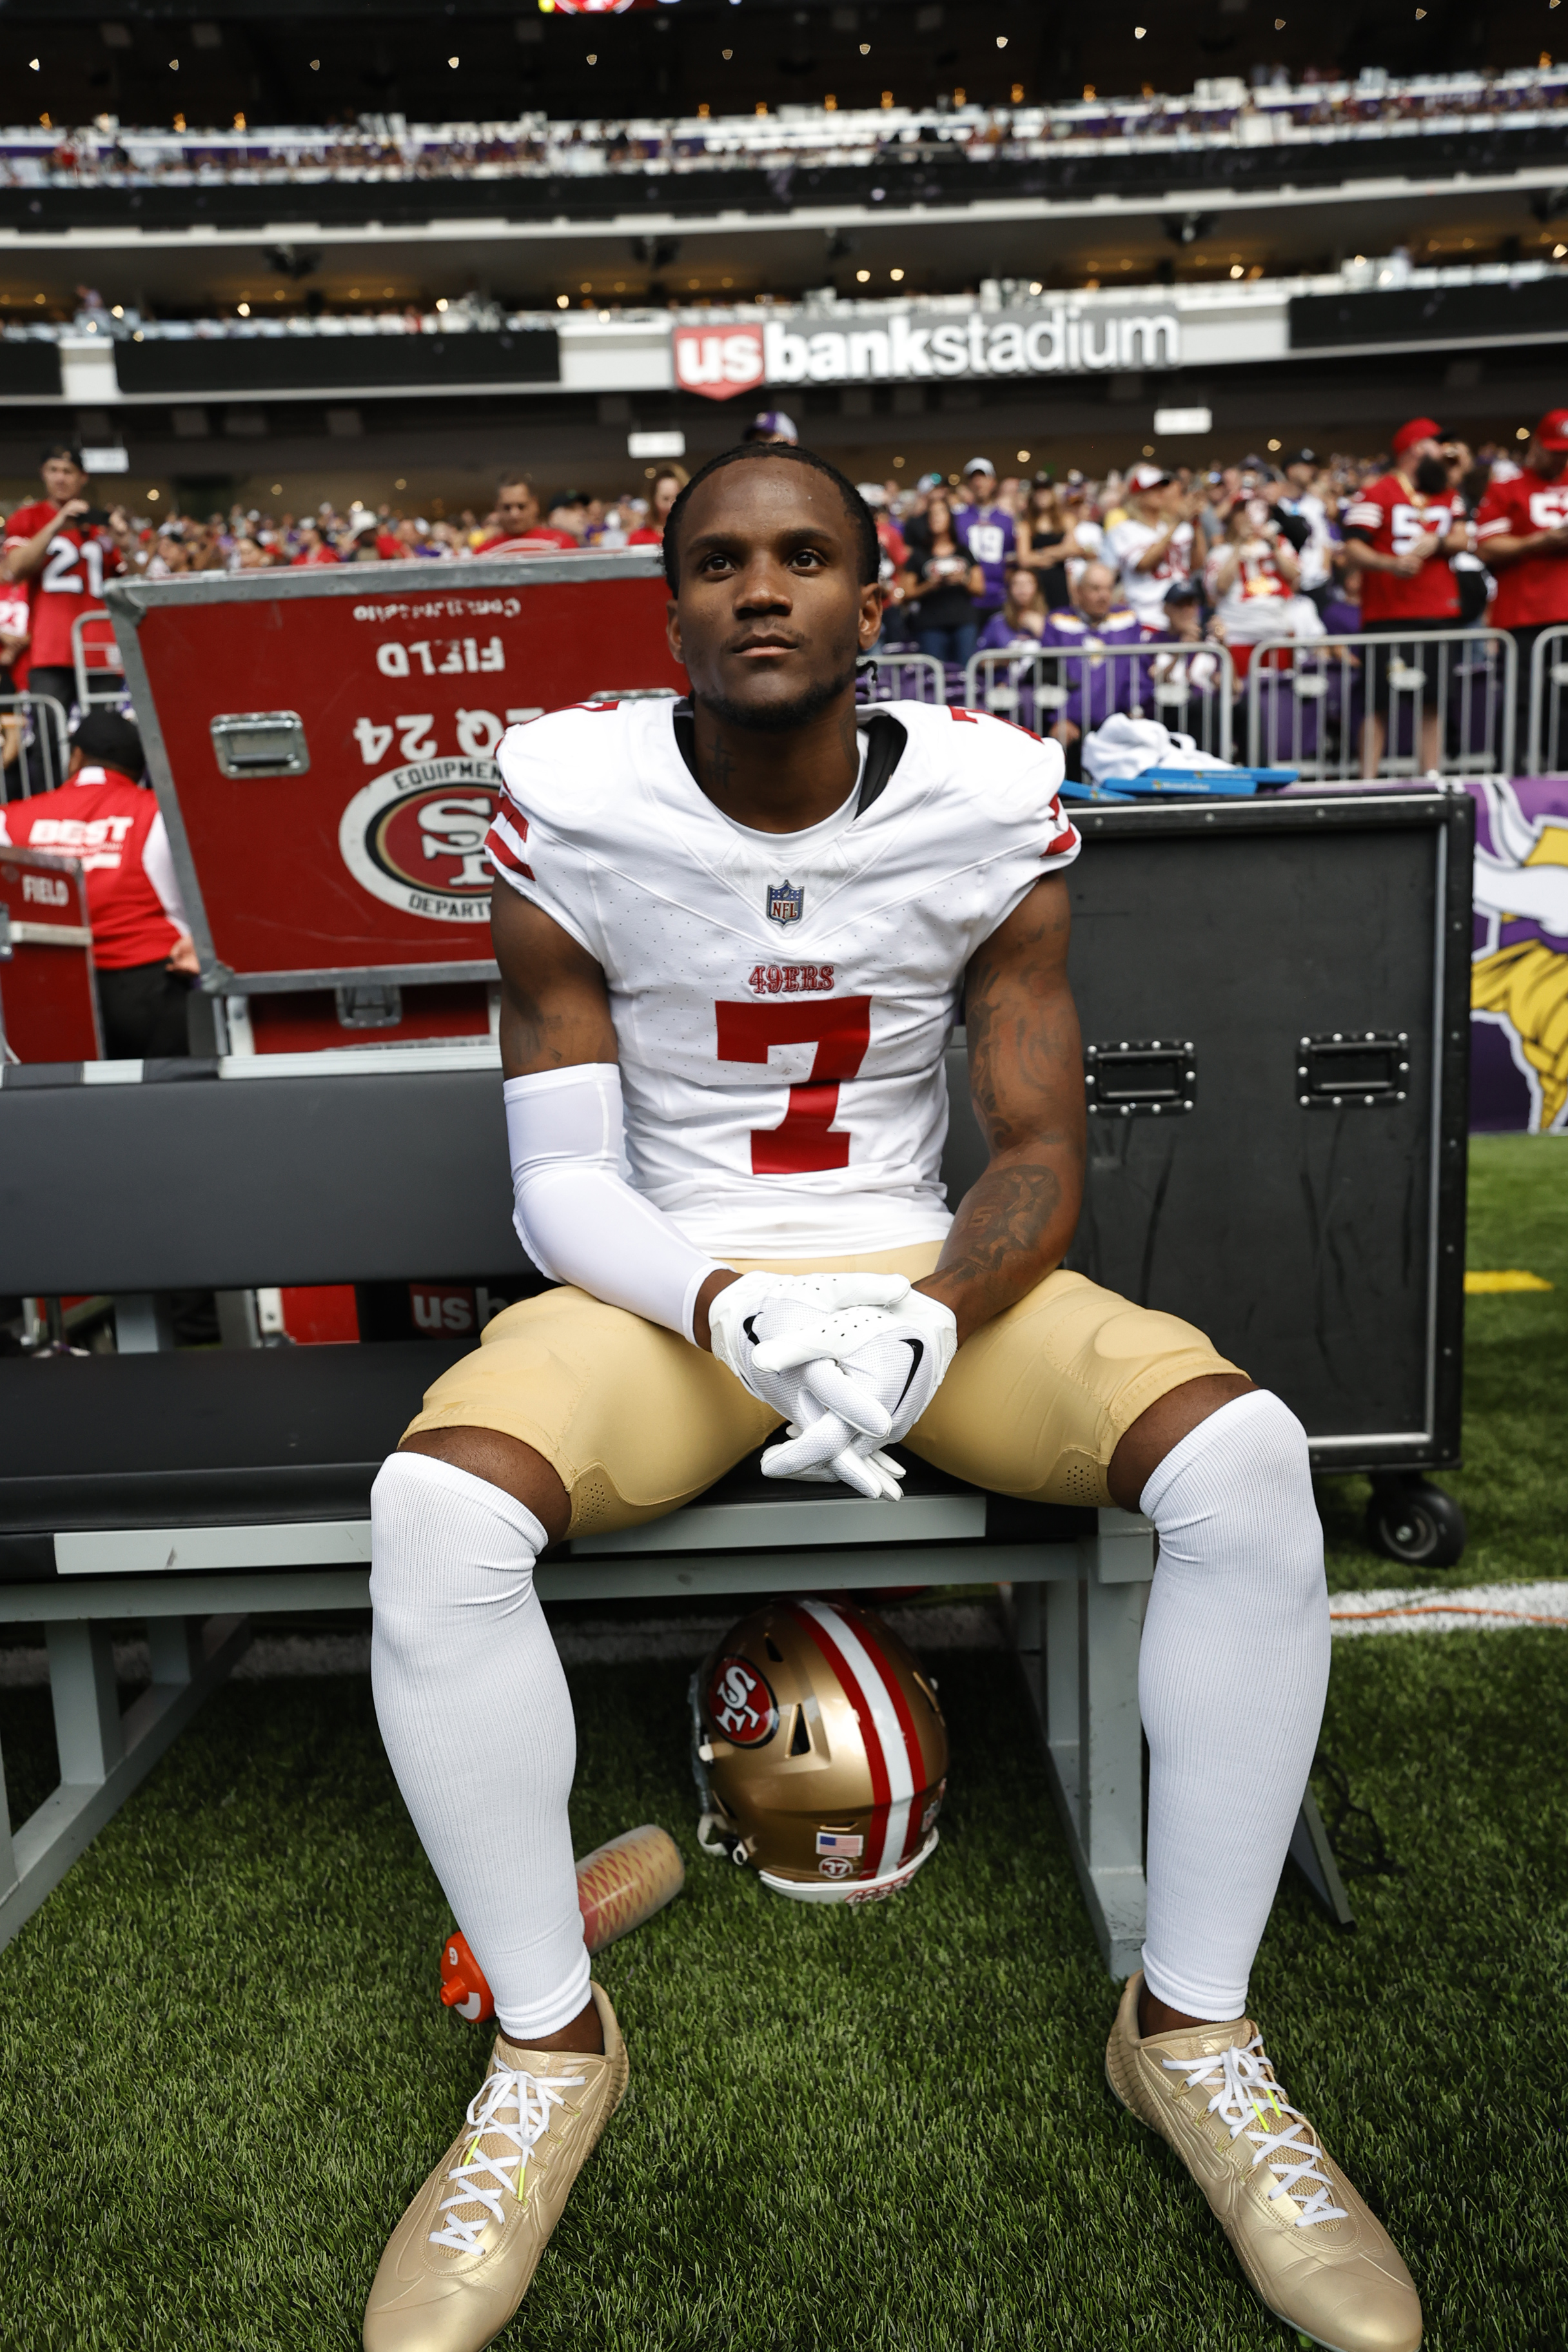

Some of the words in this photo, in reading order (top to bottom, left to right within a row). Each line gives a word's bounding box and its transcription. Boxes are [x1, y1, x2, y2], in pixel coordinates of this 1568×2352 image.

[42, 534, 104, 598] 21
[353, 713, 438, 765] 24
[455, 707, 545, 759] Q
[29, 816, 134, 845] BEST
[22, 875, 69, 907] FIELD
[408, 892, 491, 917] DEPART
[772, 901, 798, 919] NFL
[749, 965, 834, 994] 49ERS
[714, 995, 873, 1176] 7
[413, 1295, 472, 1330] us
[823, 1861, 848, 1877] 37
